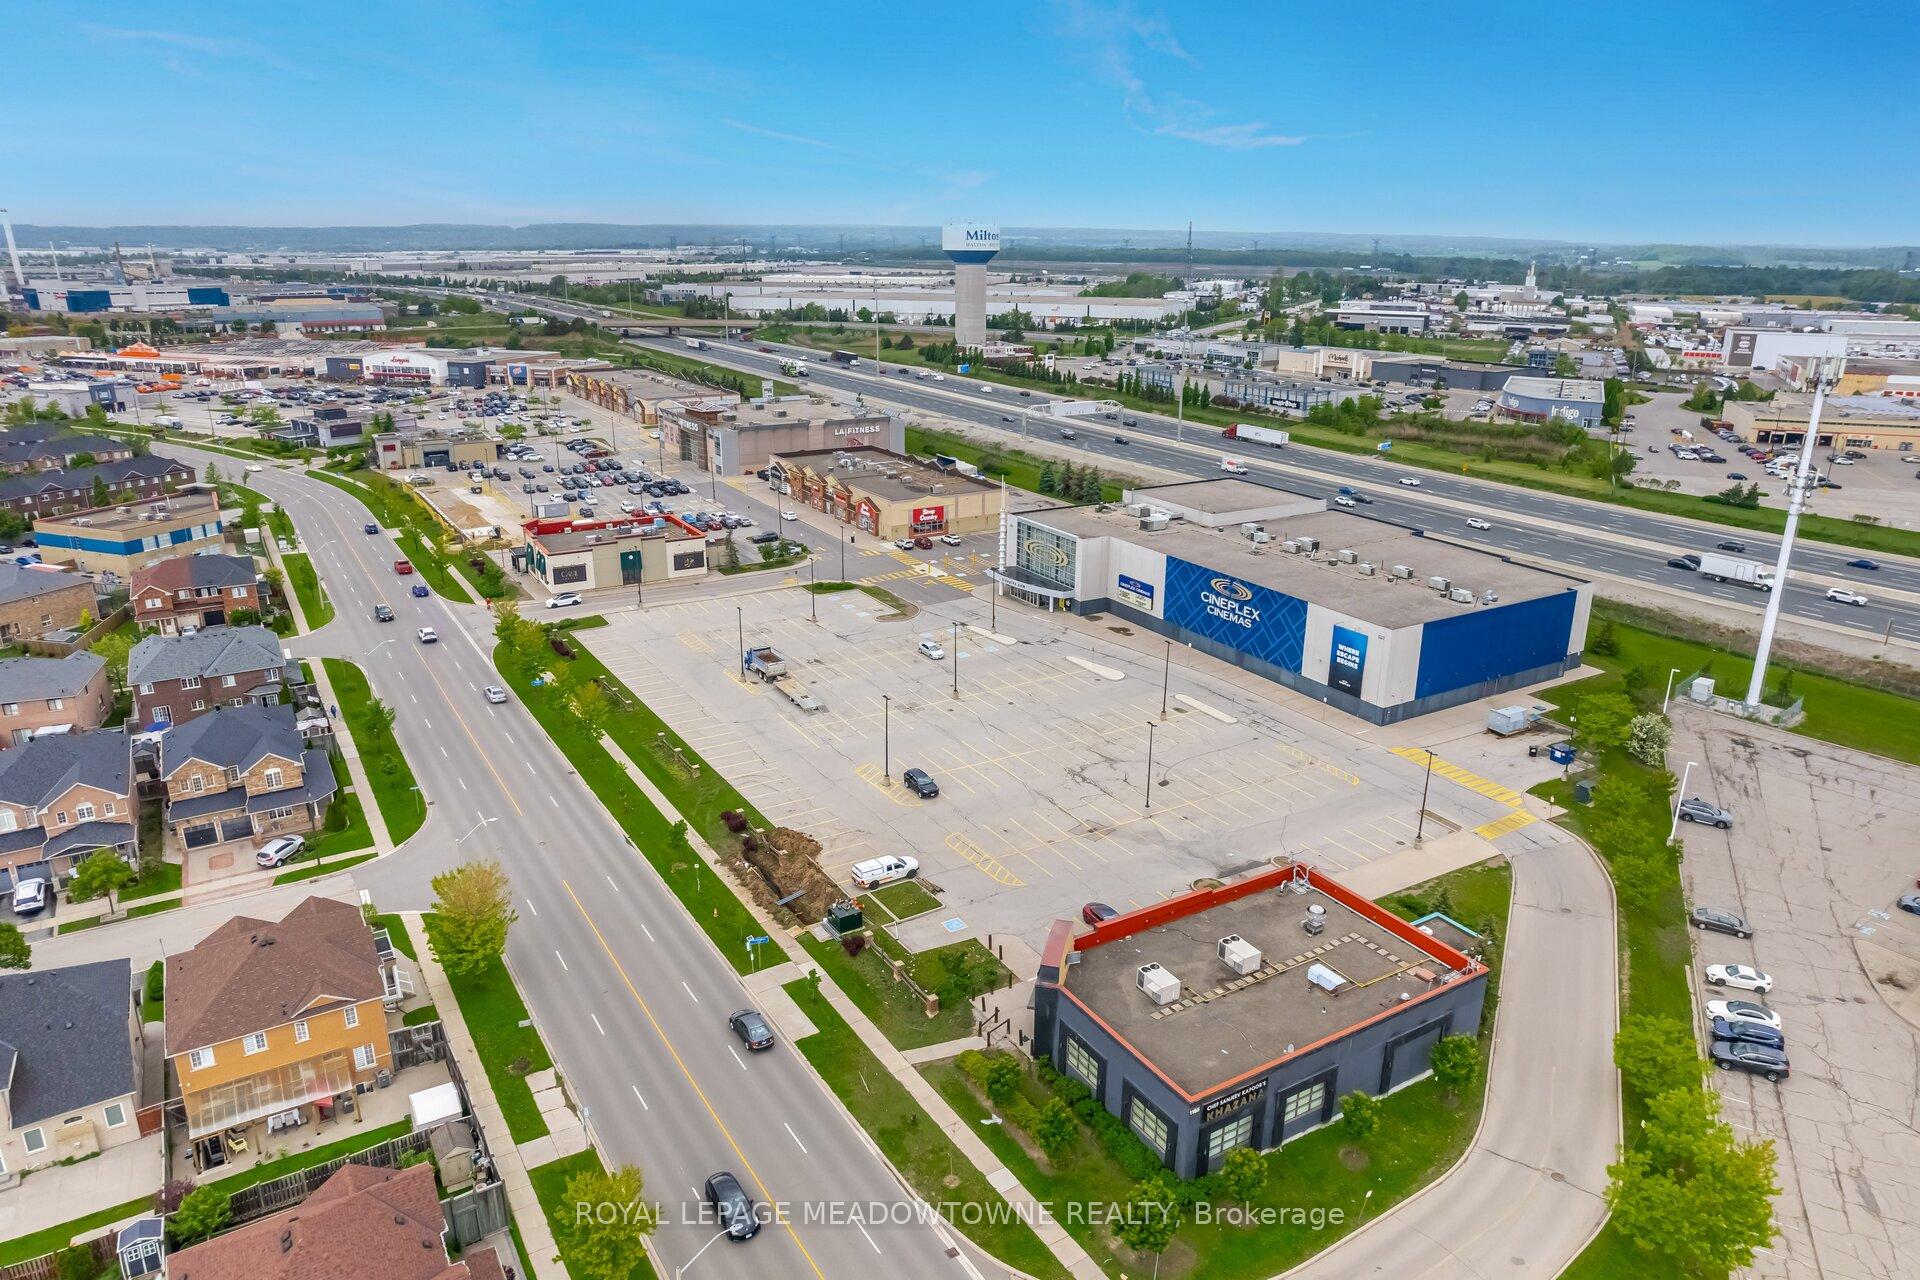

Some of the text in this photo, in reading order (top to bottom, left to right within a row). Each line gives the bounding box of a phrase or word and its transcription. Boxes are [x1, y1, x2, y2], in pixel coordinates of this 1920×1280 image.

[1551, 404, 1580, 419] Indigo
[834, 425, 880, 436] LA FITNESS
[1200, 591, 1261, 622] CINEPLEX
[1207, 605, 1252, 629] CINEMAS
[1336, 649, 1360, 664] ESCAPE
[1338, 643, 1360, 657] WHERE
[1336, 656, 1358, 670] BEGINS
[1206, 1102, 1219, 1111] CHEF
[1241, 1080, 1267, 1095] KAPOOR'S
[1206, 1089, 1266, 1122] KHAZANA
